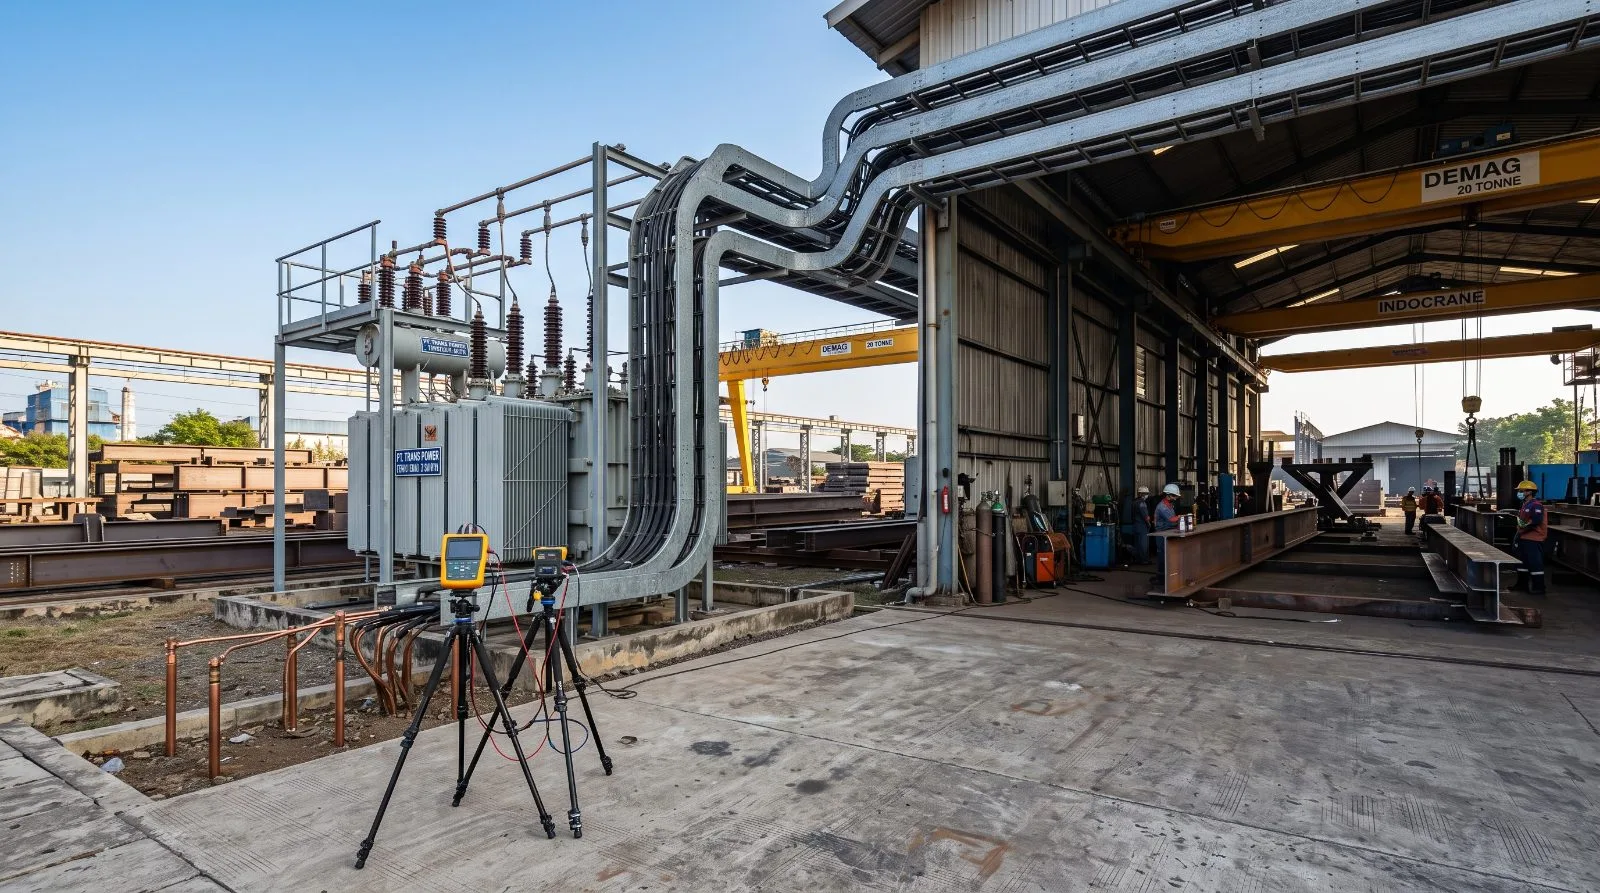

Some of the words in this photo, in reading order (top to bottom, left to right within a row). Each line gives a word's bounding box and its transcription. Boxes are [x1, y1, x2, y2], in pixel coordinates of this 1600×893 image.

[1424, 157, 1521, 189] DEMAG
[1457, 184, 1472, 195] 20
[1477, 175, 1521, 192] TONNE
[1380, 291, 1484, 313] INDOCRANE
[823, 343, 848, 353] DEMAG
[875, 339, 893, 347] TONNE
[404, 451, 421, 462] TRANS
[421, 450, 440, 461] POWER
